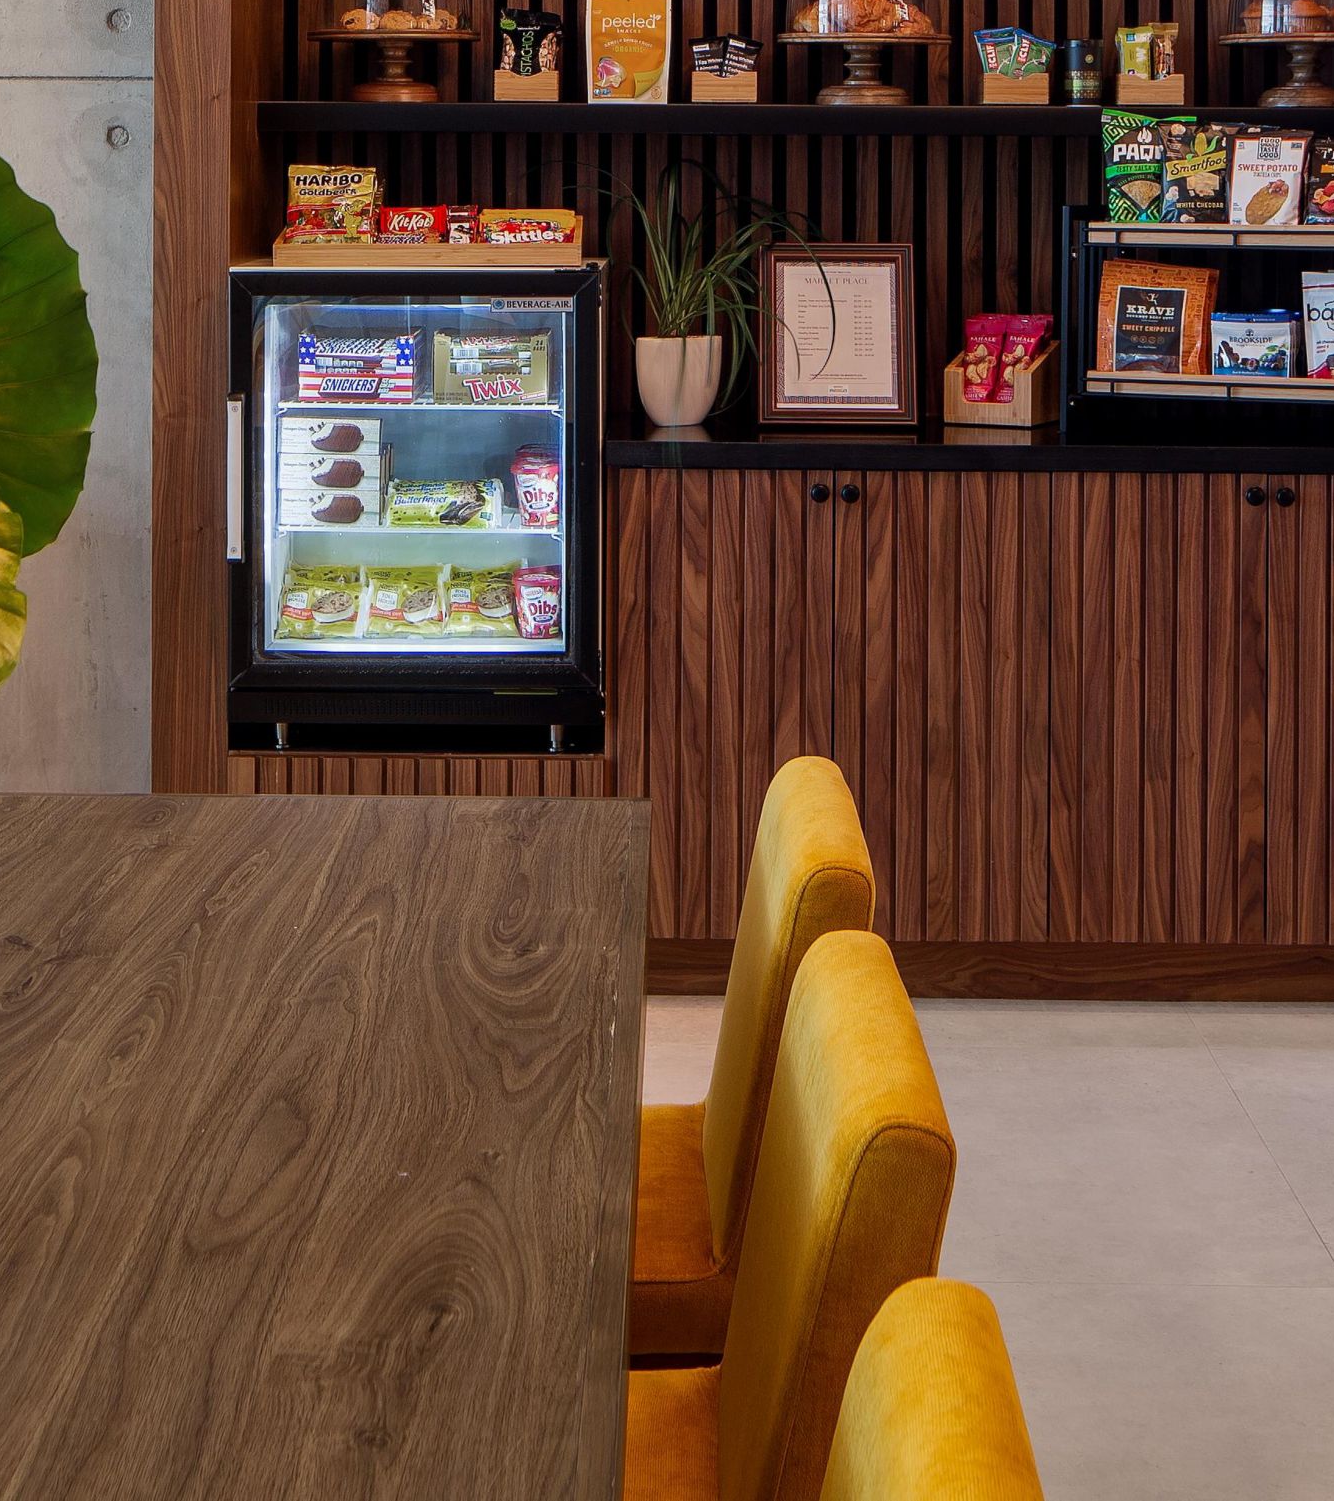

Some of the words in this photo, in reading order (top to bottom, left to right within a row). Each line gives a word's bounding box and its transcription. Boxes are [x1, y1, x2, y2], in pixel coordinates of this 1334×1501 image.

[602, 12, 656, 33] peeled
[520, 30, 534, 75] ISTACHOS
[1238, 163, 1266, 171] SWEET
[1267, 164, 1298, 172] POTATO
[295, 173, 364, 187] HARIBO
[299, 188, 357, 197] Goldbears
[490, 230, 565, 244] Skittles
[805, 277, 839, 285] MARET
[842, 277, 869, 285] PLACE
[1125, 304, 1175, 316] KRAVE
[1121, 323, 1144, 332] SWEET
[1144, 325, 1176, 333] CHIPOTLE
[1229, 335, 1273, 344] BROOKSIDE
[322, 378, 376, 391] SNICKERS
[464, 374, 523, 401] Twix
[528, 600, 557, 615] Dibs
